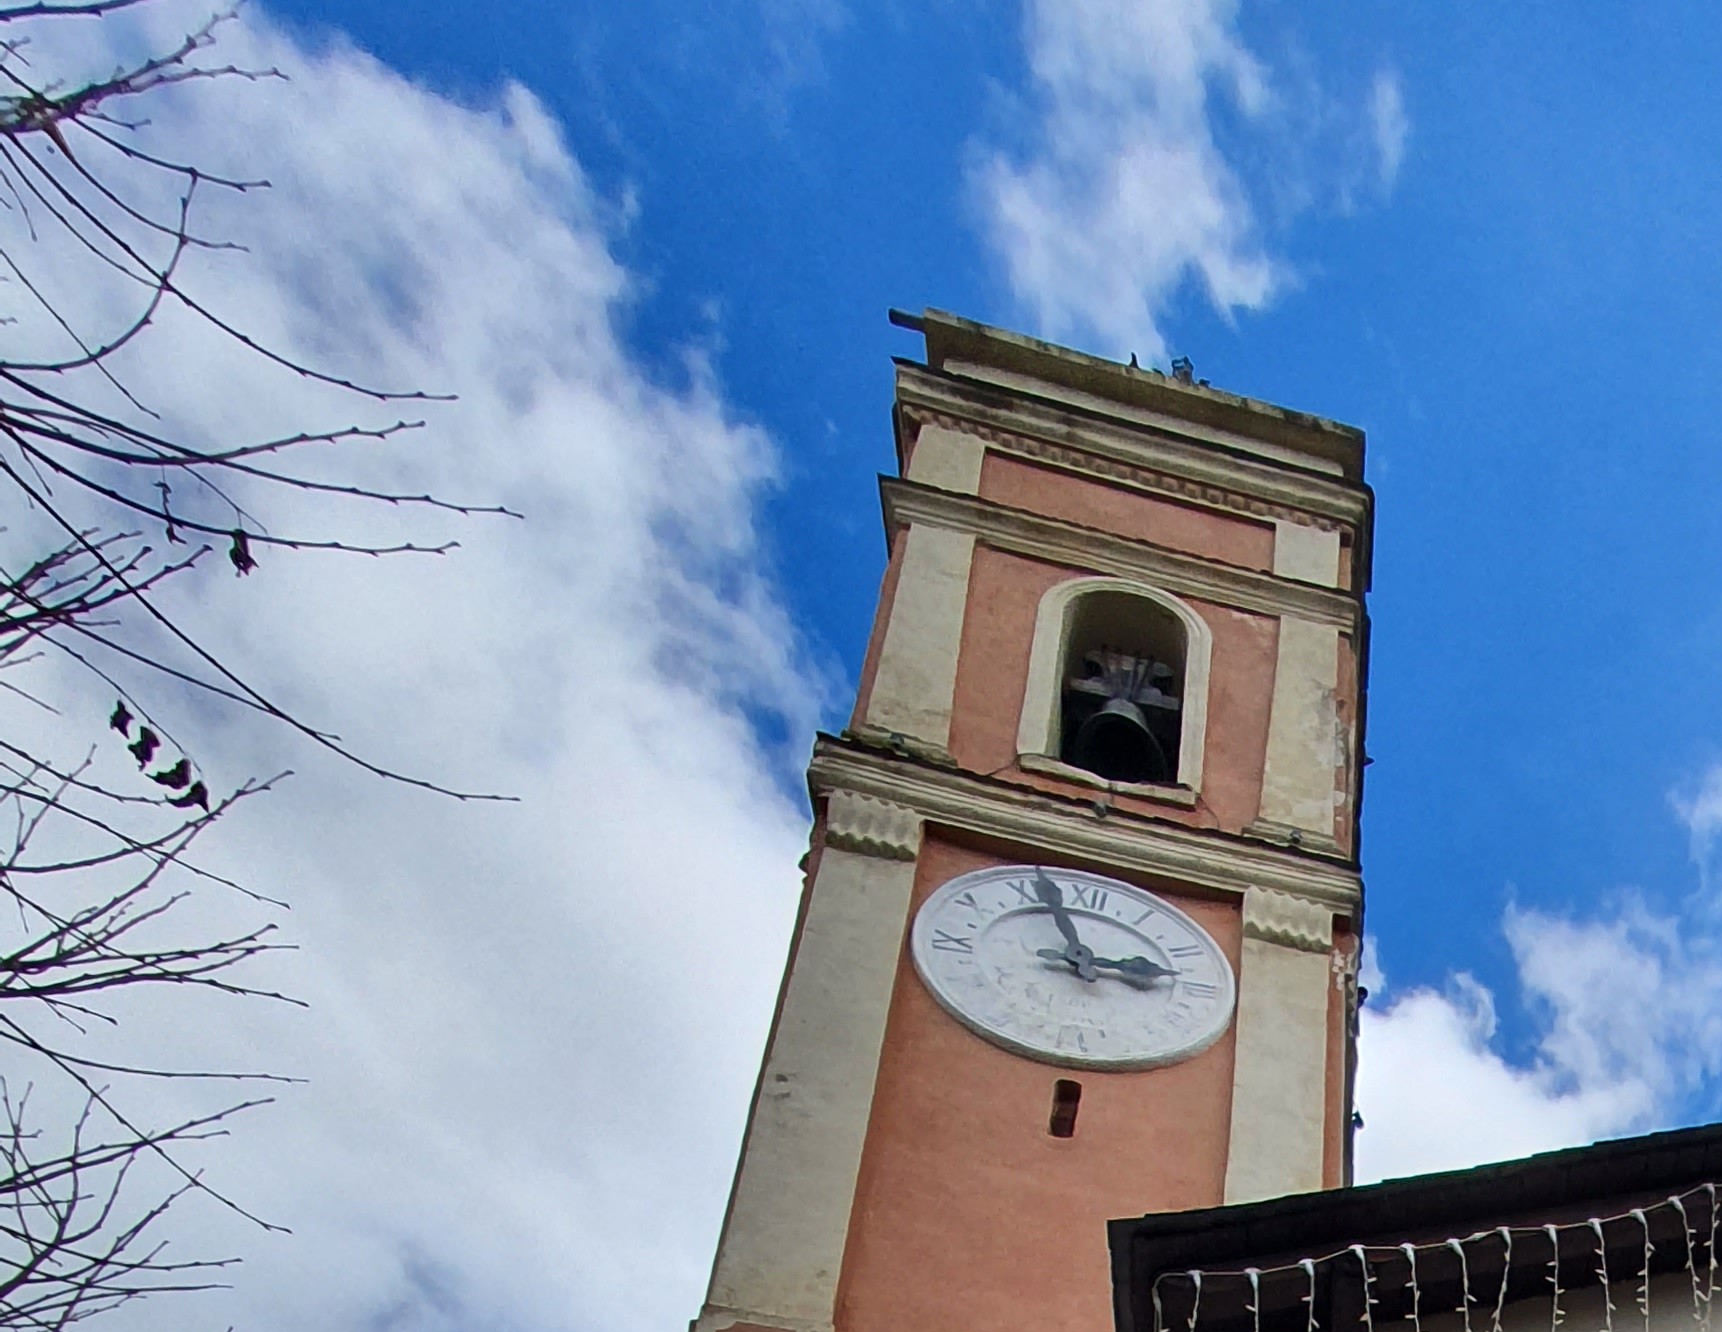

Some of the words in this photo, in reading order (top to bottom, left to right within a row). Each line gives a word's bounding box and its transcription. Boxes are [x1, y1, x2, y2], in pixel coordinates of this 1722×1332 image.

[1071, 883, 1108, 911] XII
[932, 928, 974, 955] IX
[1168, 944, 1204, 958] II
